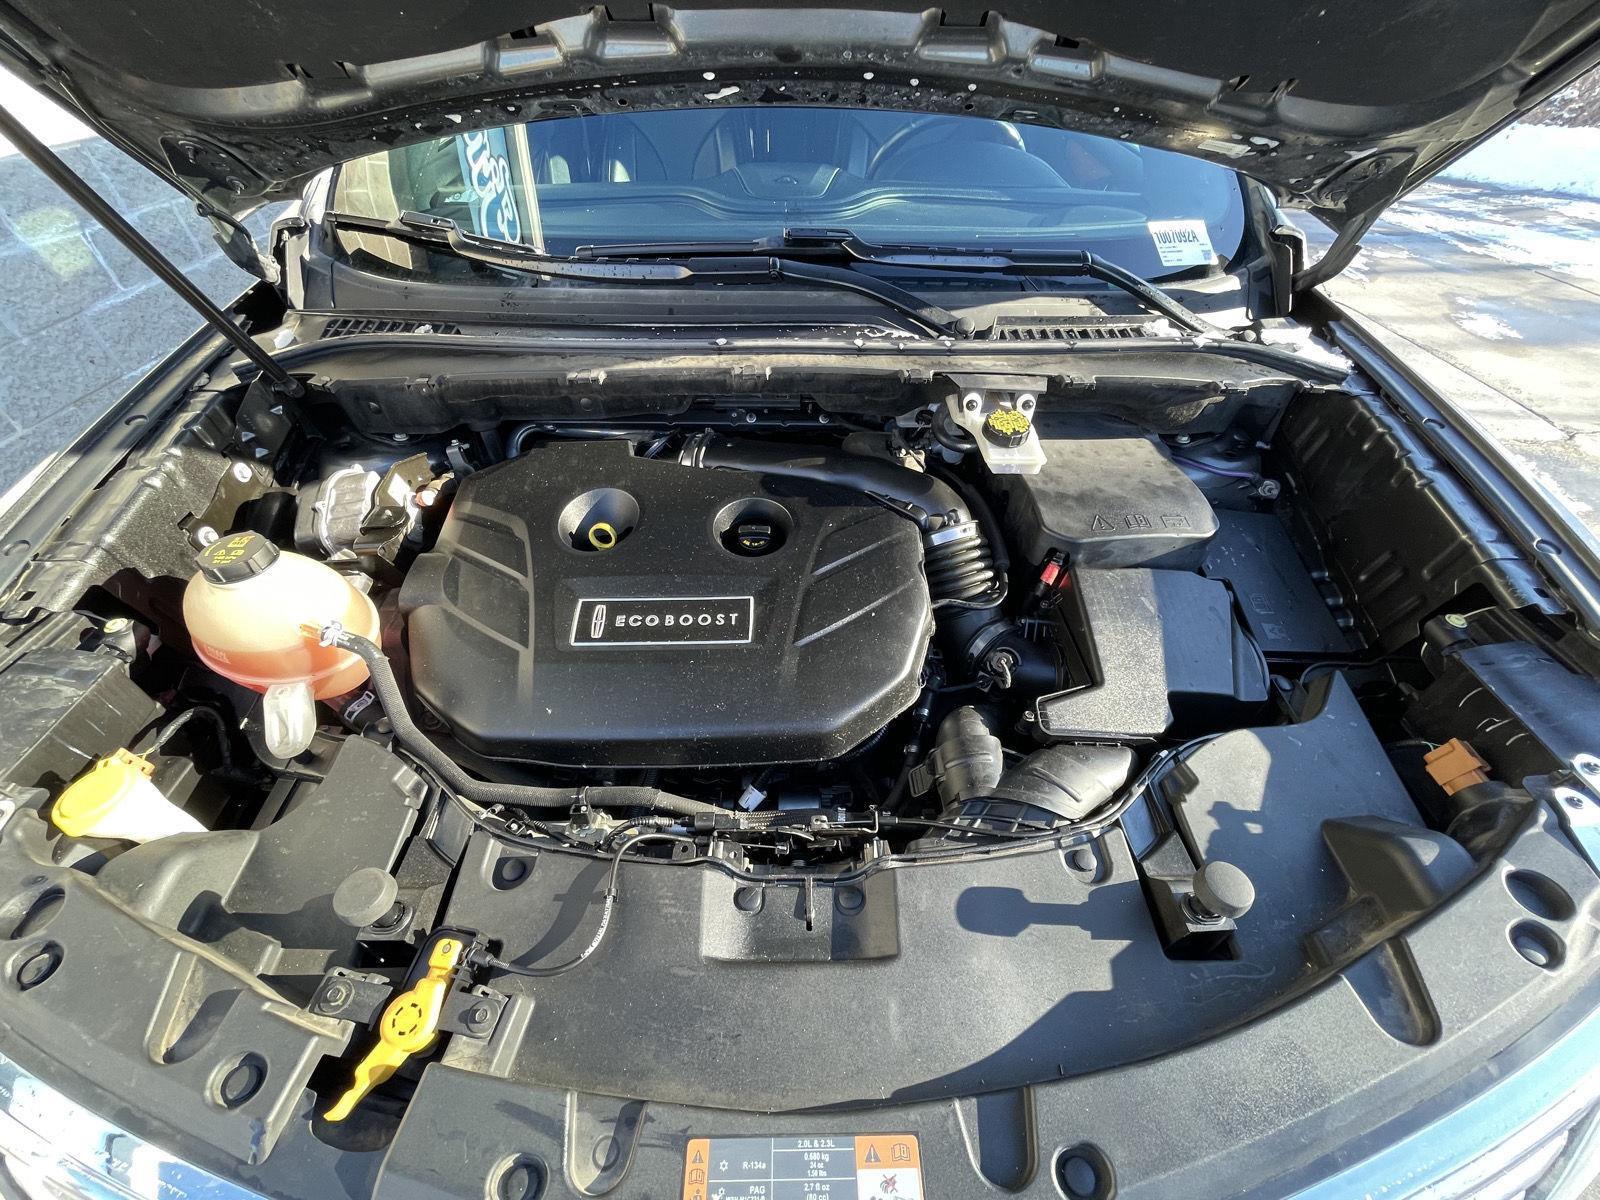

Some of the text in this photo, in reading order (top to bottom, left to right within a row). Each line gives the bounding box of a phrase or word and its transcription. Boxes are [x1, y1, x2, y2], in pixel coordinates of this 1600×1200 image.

[615, 613, 739, 627] ECOBOOST
[798, 1139, 836, 1148] 2.0L & 2.3L
[822, 1152, 829, 1162] kg
[743, 1161, 766, 1170] R-134a
[749, 1185, 766, 1195] PAG
[804, 1182, 814, 1191] 2.7
